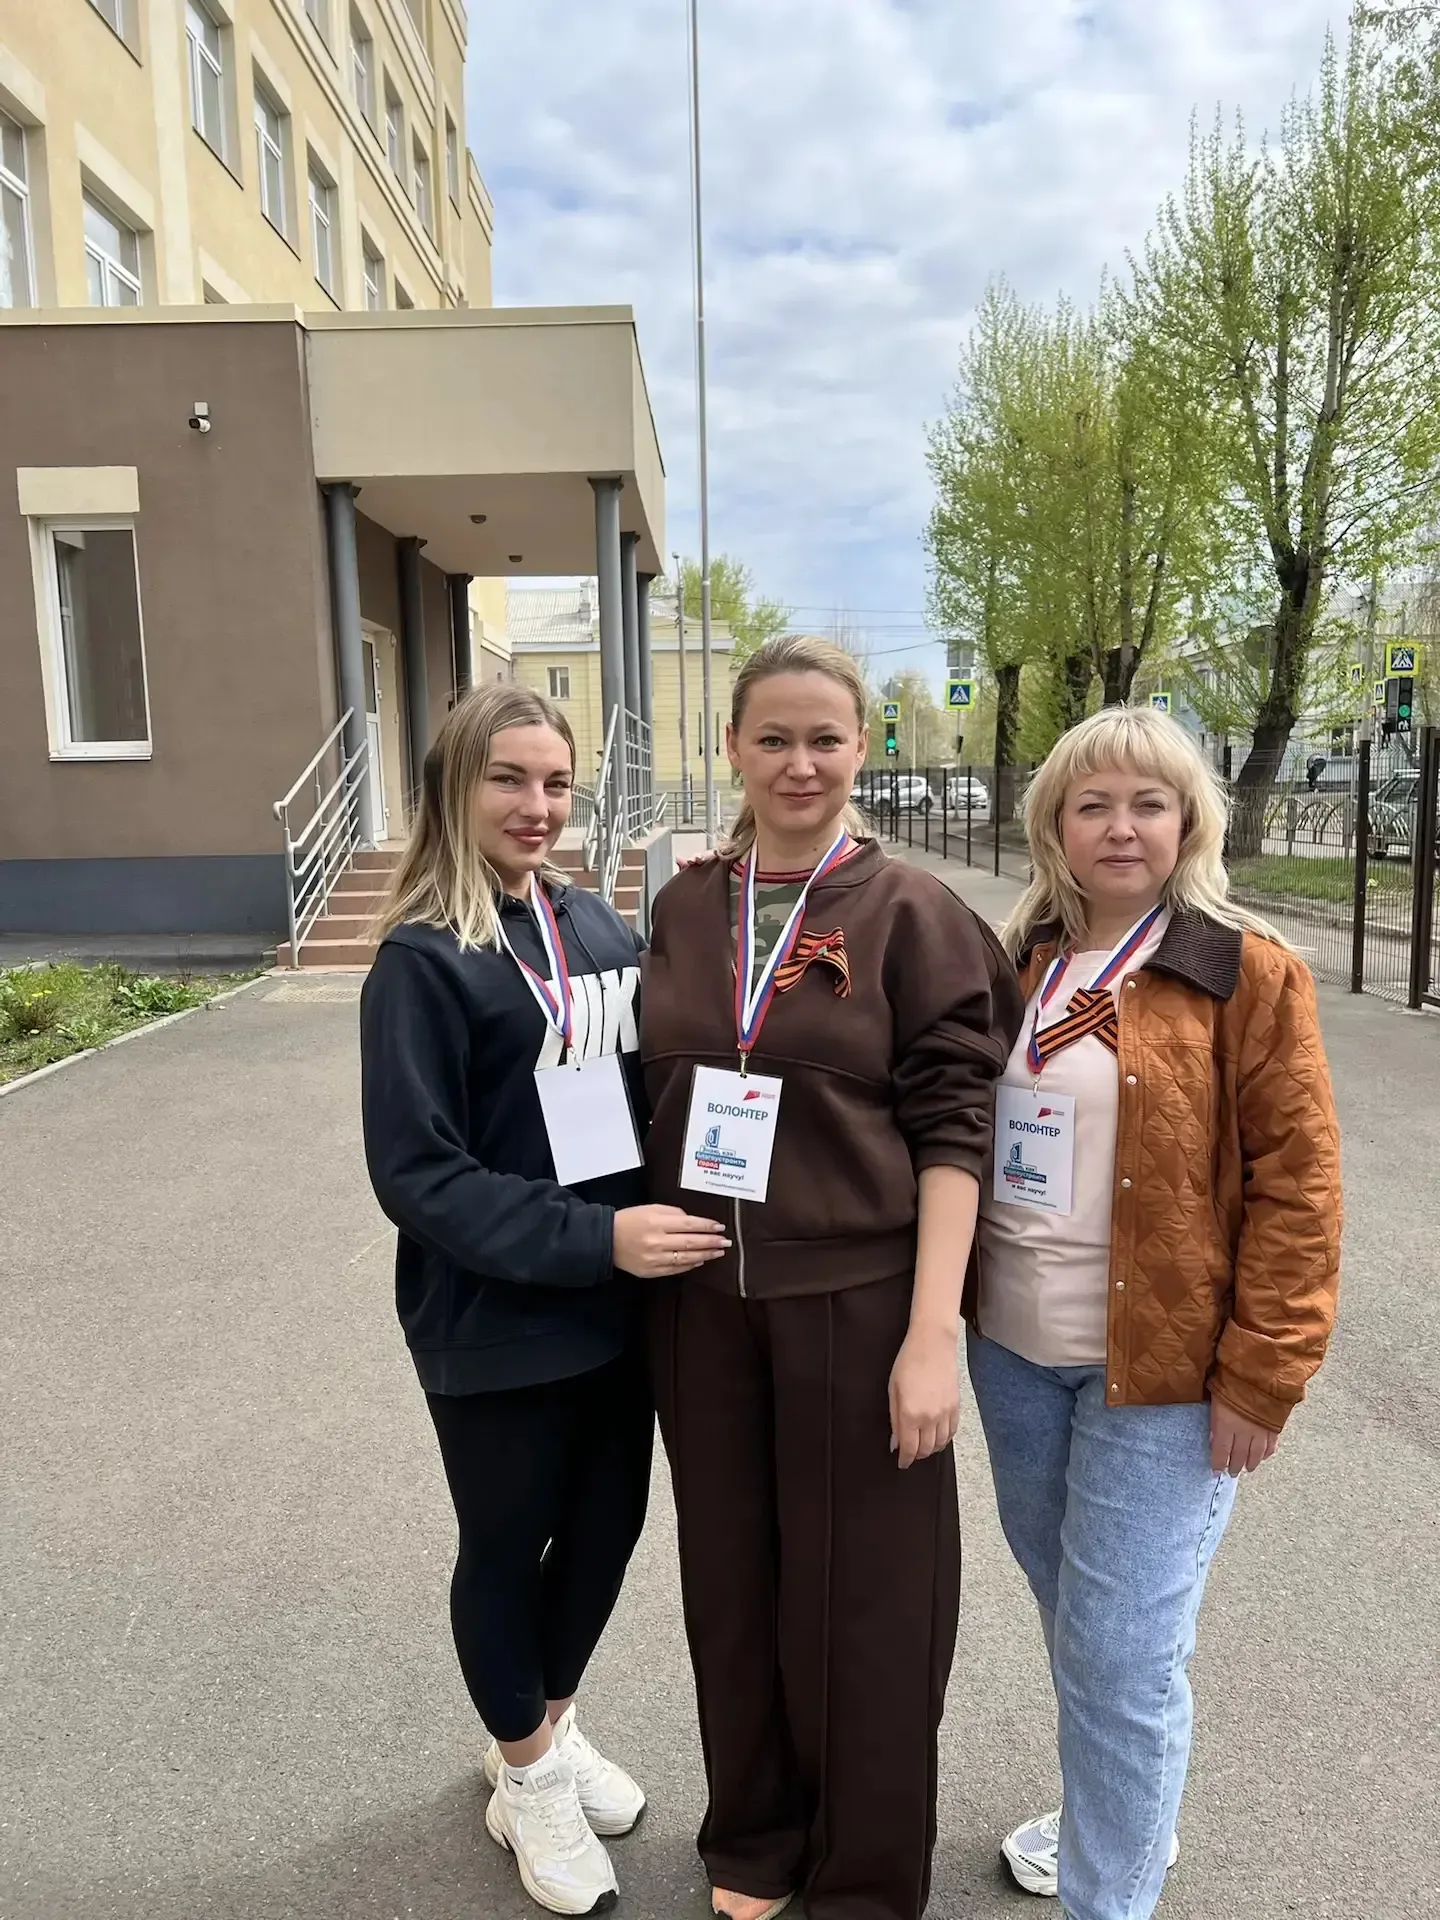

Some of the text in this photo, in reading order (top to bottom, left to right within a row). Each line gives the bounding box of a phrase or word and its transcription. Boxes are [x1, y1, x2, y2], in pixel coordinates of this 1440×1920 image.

[535, 967, 641, 1070] NIK
[707, 1102, 768, 1121] ВОЛОНТЕР
[1009, 1119, 1061, 1137] ВОЛОНТЕР
